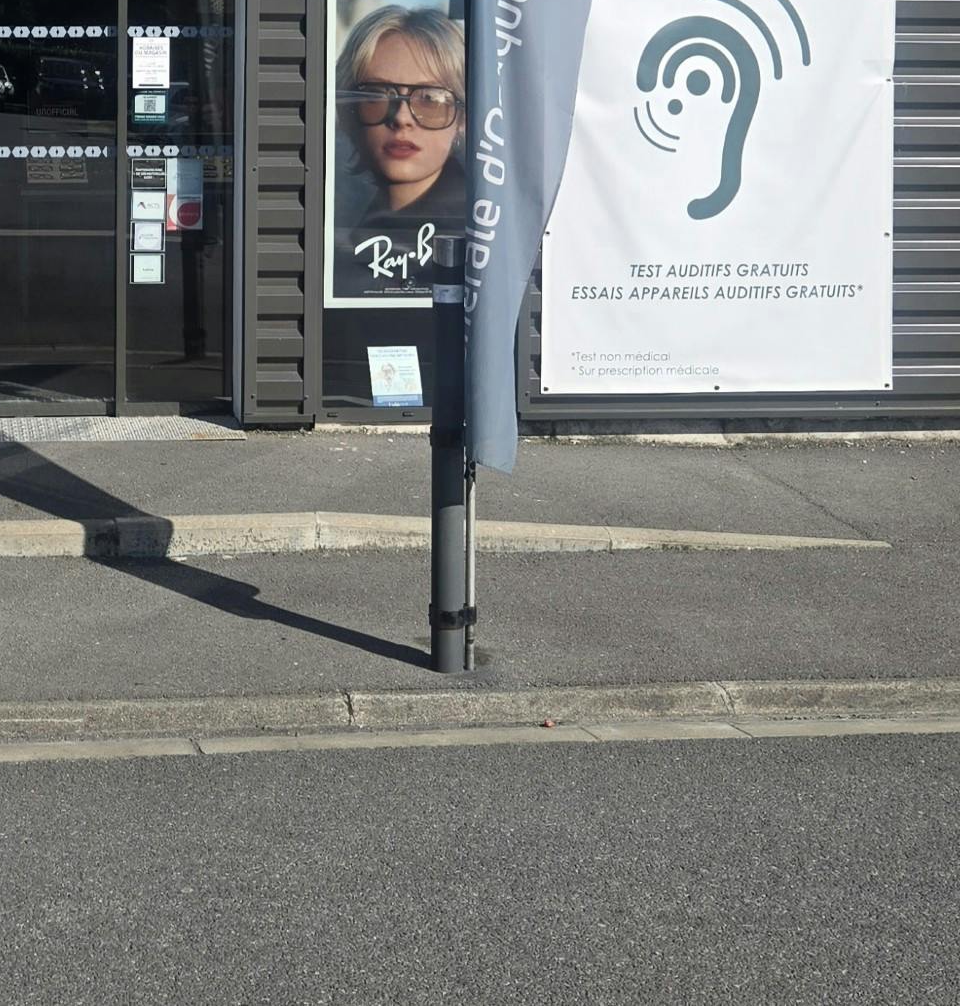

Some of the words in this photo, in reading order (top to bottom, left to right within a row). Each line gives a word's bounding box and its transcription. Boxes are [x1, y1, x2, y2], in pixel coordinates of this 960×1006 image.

[354, 222, 436, 280] Ray-B
[629, 264, 664, 279] TEST
[665, 263, 732, 278] AUDITIFS
[736, 263, 810, 278] GRATUITS
[571, 286, 624, 301] ESSAIS
[628, 286, 710, 301] APPAREILS
[713, 285, 782, 301] AUDITIFS
[599, 352, 622, 362] non
[624, 351, 672, 363] médical
[578, 366, 596, 377] Sur
[597, 365, 664, 378] prescription
[665, 364, 720, 377] médicale
